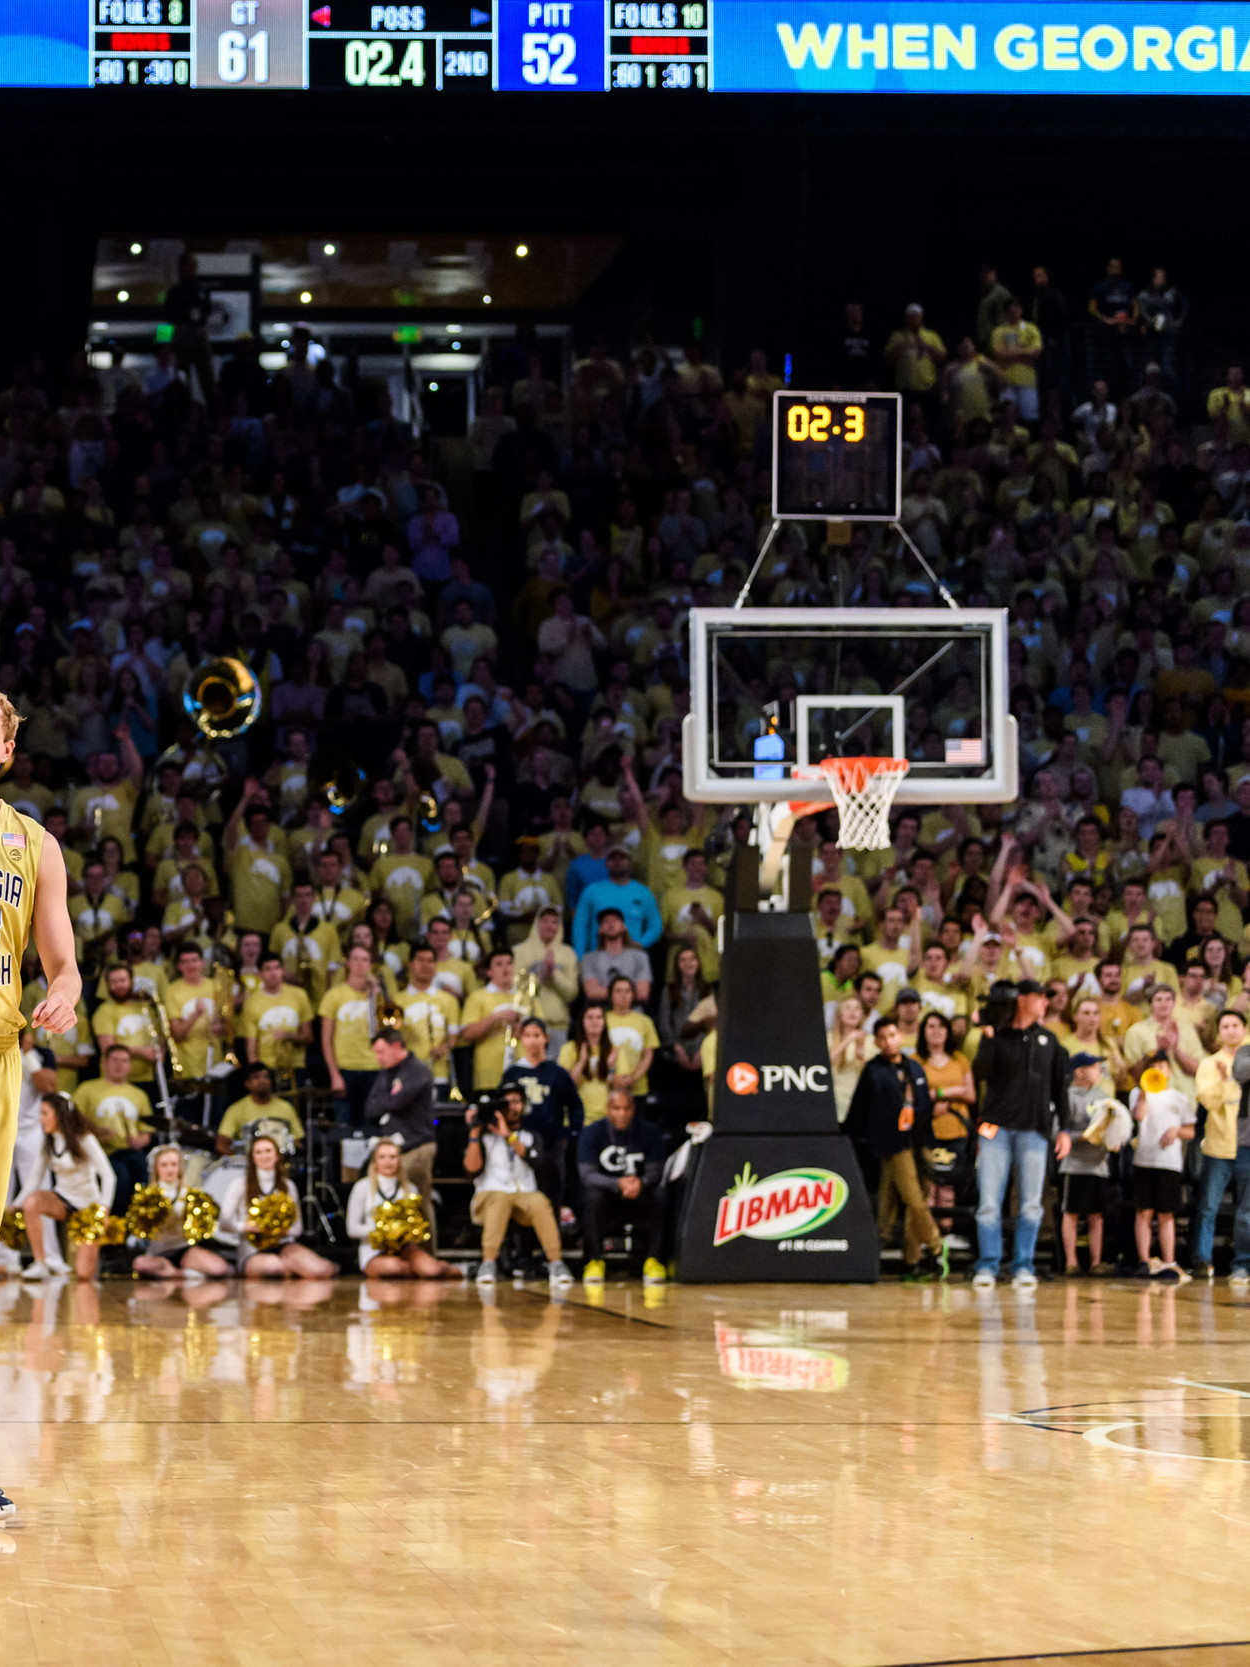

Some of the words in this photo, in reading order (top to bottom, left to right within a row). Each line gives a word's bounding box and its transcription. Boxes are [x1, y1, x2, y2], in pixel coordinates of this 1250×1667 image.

[99, 0, 162, 24] FOULS
[231, 0, 260, 25] GT
[371, 5, 425, 31] POSS
[528, 3, 574, 27] PITT
[614, 3, 677, 28] FOULS
[681, 3, 704, 28] 10
[218, 30, 269, 83] 61
[522, 33, 578, 85] 52
[776, 23, 976, 70] WHEN
[994, 24, 1250, 71] GEORGI
[345, 40, 426, 86] 02.4
[444, 51, 488, 76] 2ND
[645, 63, 656, 88] 1
[694, 64, 706, 88] 1
[787, 405, 864, 442] 02.3
[760, 1065, 828, 1092] PNC
[716, 1179, 834, 1242] LIBMAN
